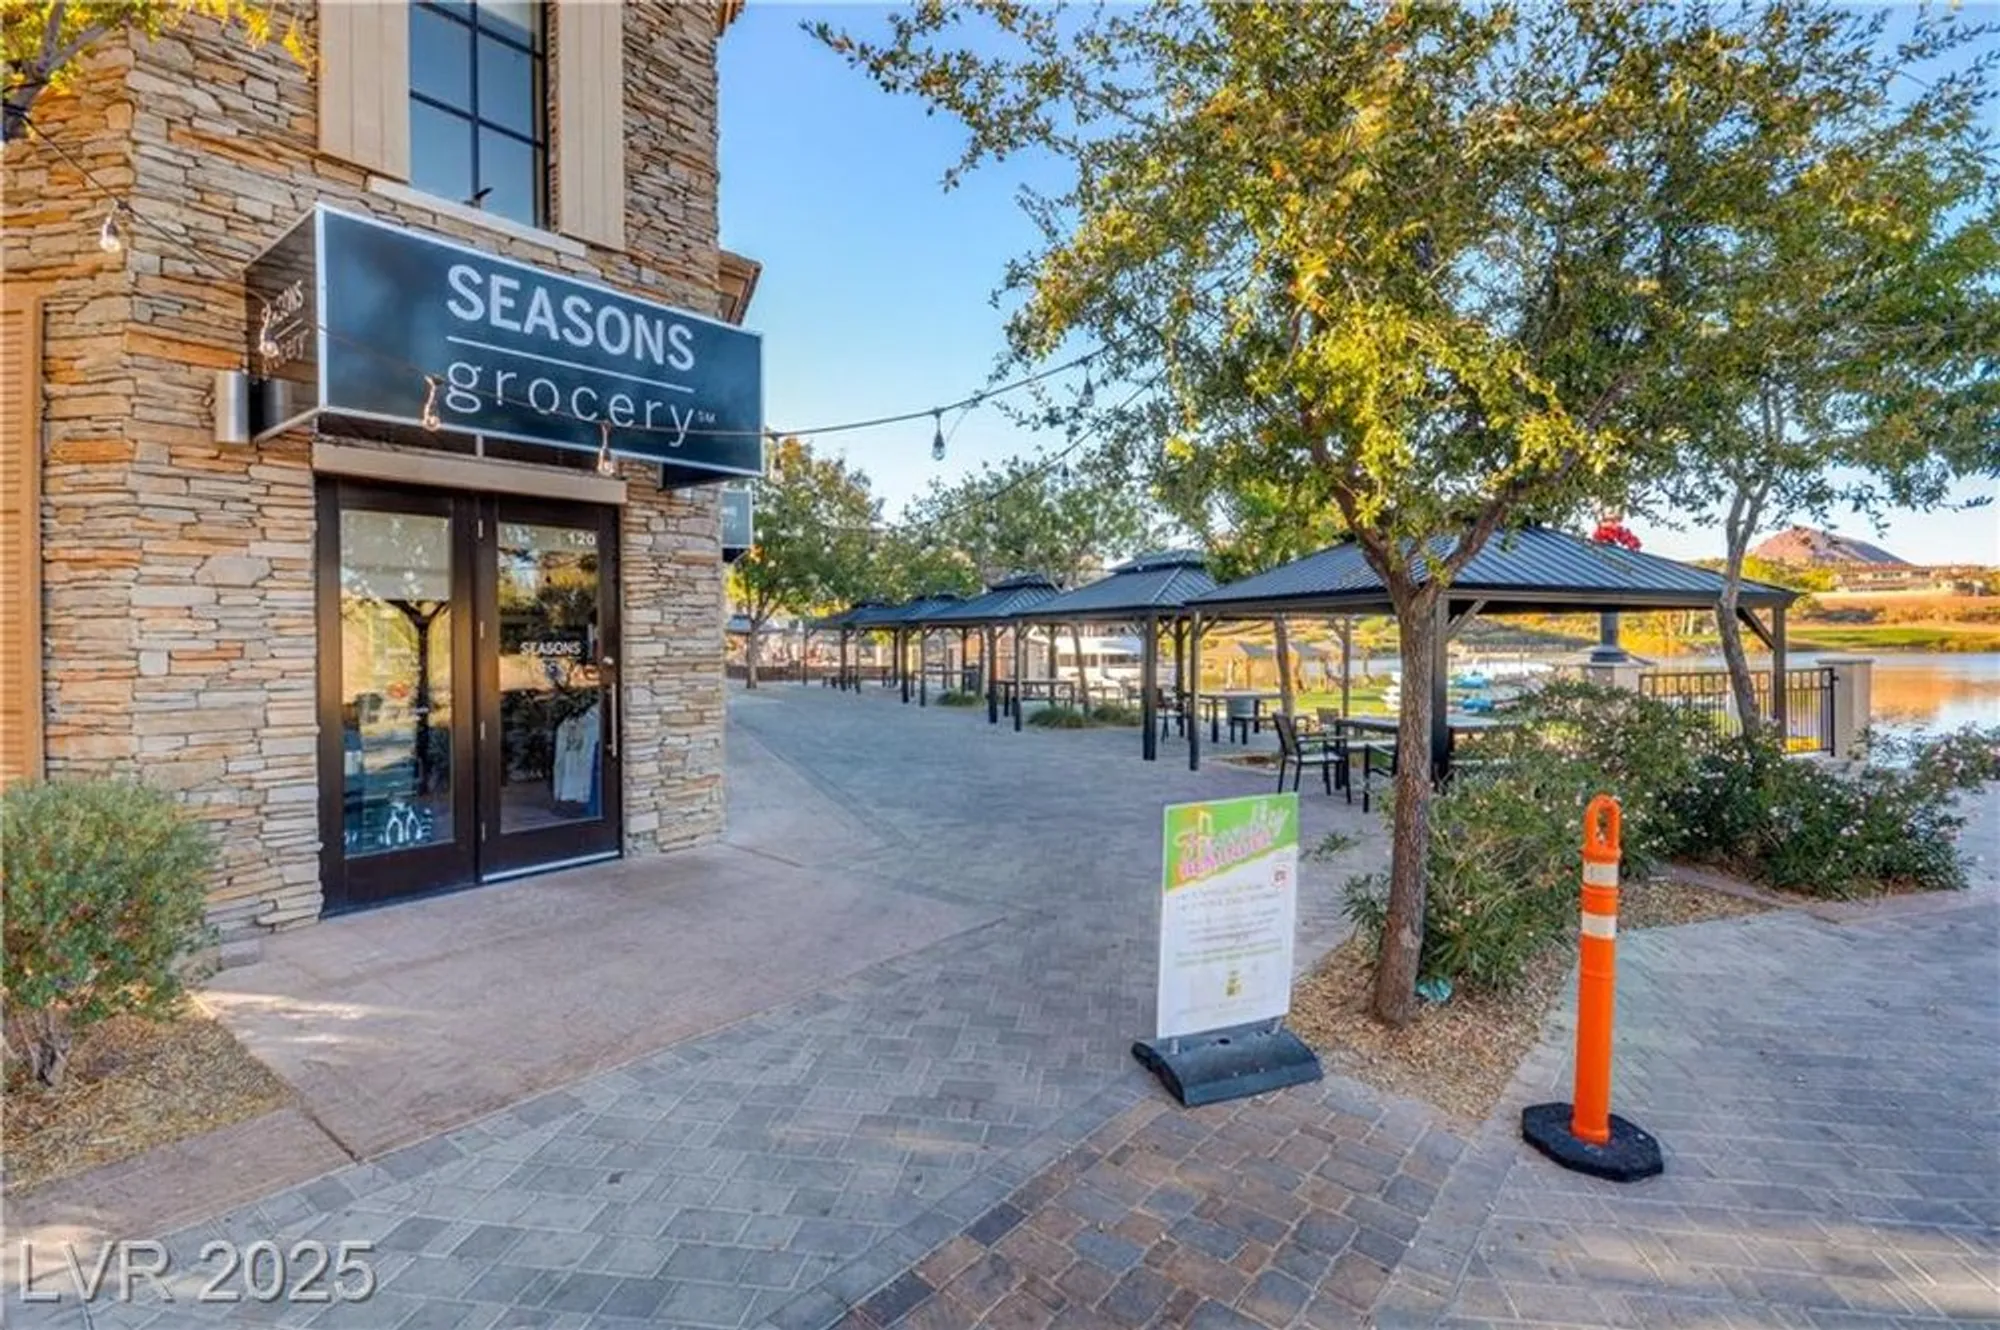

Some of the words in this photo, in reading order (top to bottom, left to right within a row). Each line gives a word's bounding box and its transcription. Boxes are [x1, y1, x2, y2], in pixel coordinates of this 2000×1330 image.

[447, 263, 696, 371] SEASONS
[445, 360, 698, 448] grocery
[568, 531, 596, 546] 120
[520, 641, 581, 656] SEASONS
